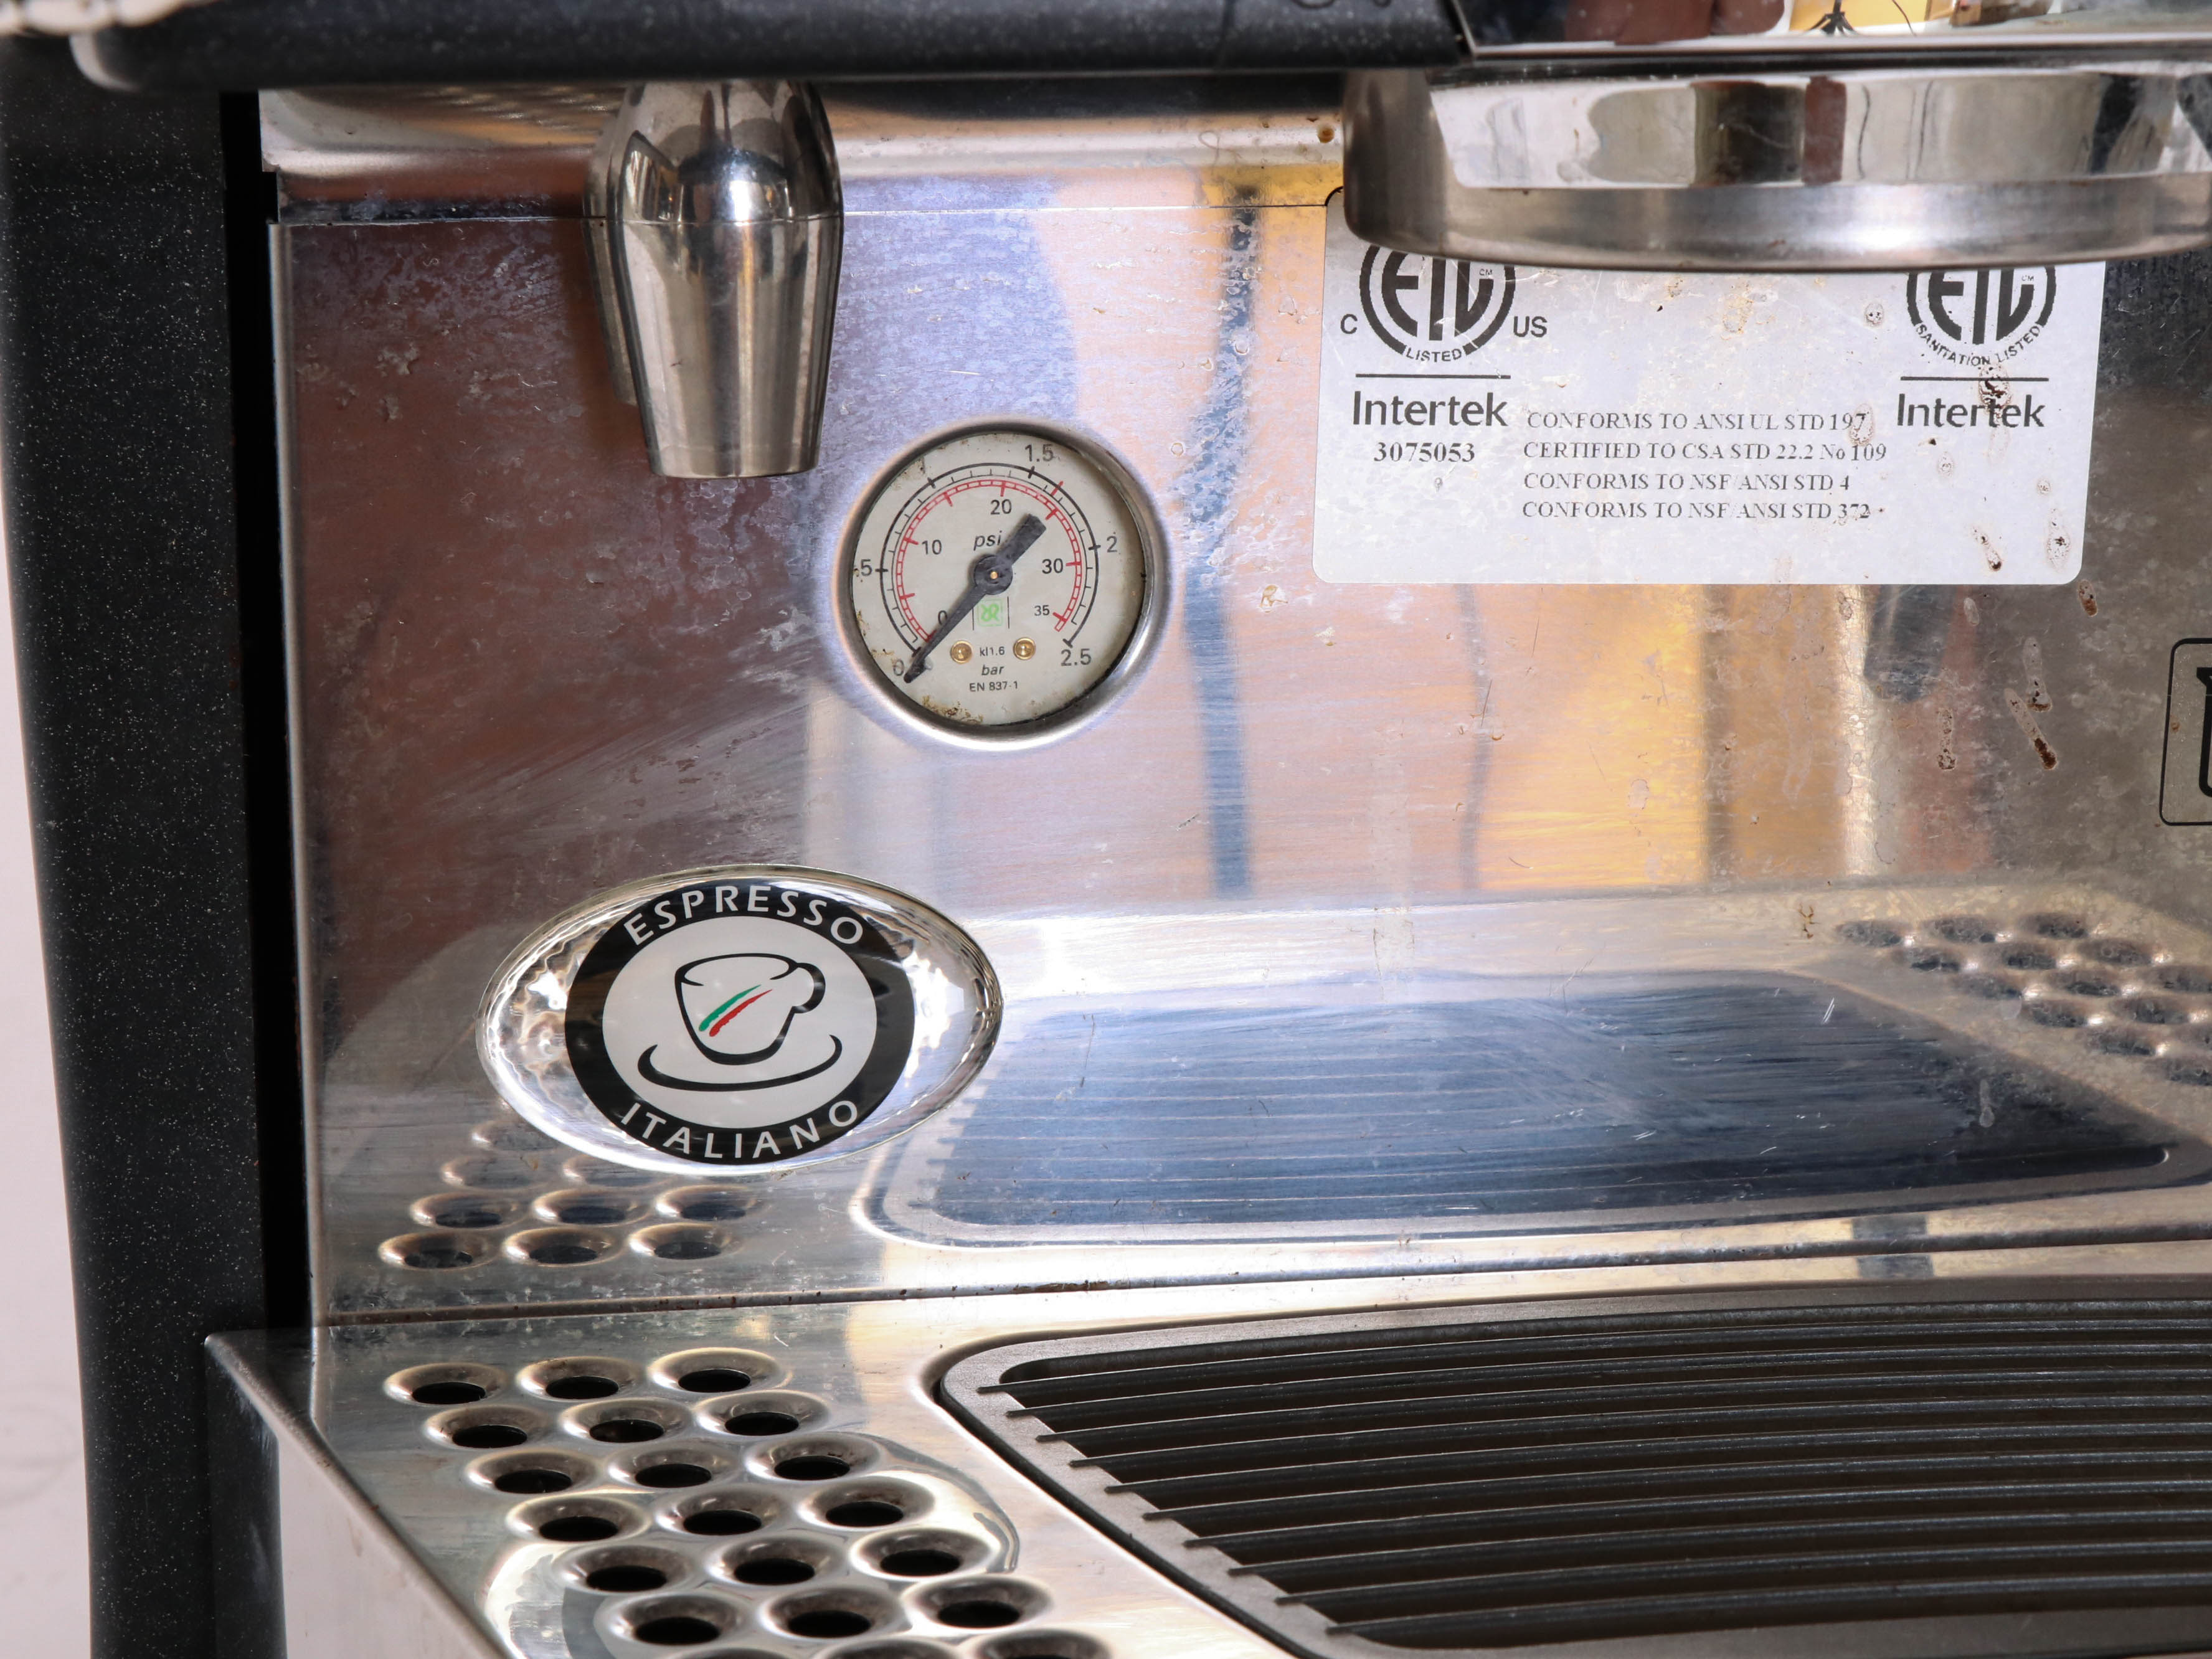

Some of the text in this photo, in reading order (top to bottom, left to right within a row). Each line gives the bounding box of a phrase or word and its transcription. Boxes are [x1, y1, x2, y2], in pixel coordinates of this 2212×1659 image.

[1341, 314, 1358, 334] C
[1513, 316, 1548, 338] US
[1916, 324, 2041, 366] SANITATION LISTED
[1406, 346, 1462, 363] LISTED
[1353, 390, 1508, 427] Intertek
[1898, 393, 2046, 428] Intertek
[1528, 412, 1652, 429] CONFORMS
[1658, 413, 1688, 429] TO
[1784, 414, 1824, 430] STD
[1830, 413, 1867, 430] 197
[1024, 444, 1054, 462] 1.5
[1373, 442, 1475, 462] 3075053
[1524, 442, 1887, 461] CERTIFIED TO CSA STD 22.2 No 109
[1524, 473, 1649, 489] CONFORMS
[1655, 474, 1685, 489] TO
[1794, 475, 1833, 490] STD
[1840, 475, 1850, 490] 4
[990, 499, 1012, 515] 20
[1523, 501, 1647, 518] CONFORMS
[1653, 503, 1682, 518] TO
[1792, 503, 1832, 519] STD
[1838, 503, 1871, 519] 372
[922, 539, 942, 555] 10
[973, 531, 1002, 550] psi
[1107, 536, 1118, 553] 2
[1042, 559, 1064, 574] 30
[1034, 605, 1050, 617] 35
[1061, 648, 1092, 667] 2.5
[981, 664, 1004, 676] bar
[969, 681, 1018, 692] EN 837-1
[623, 884, 864, 945] ESPRESSO
[620, 1099, 858, 1159] ITALIANO
